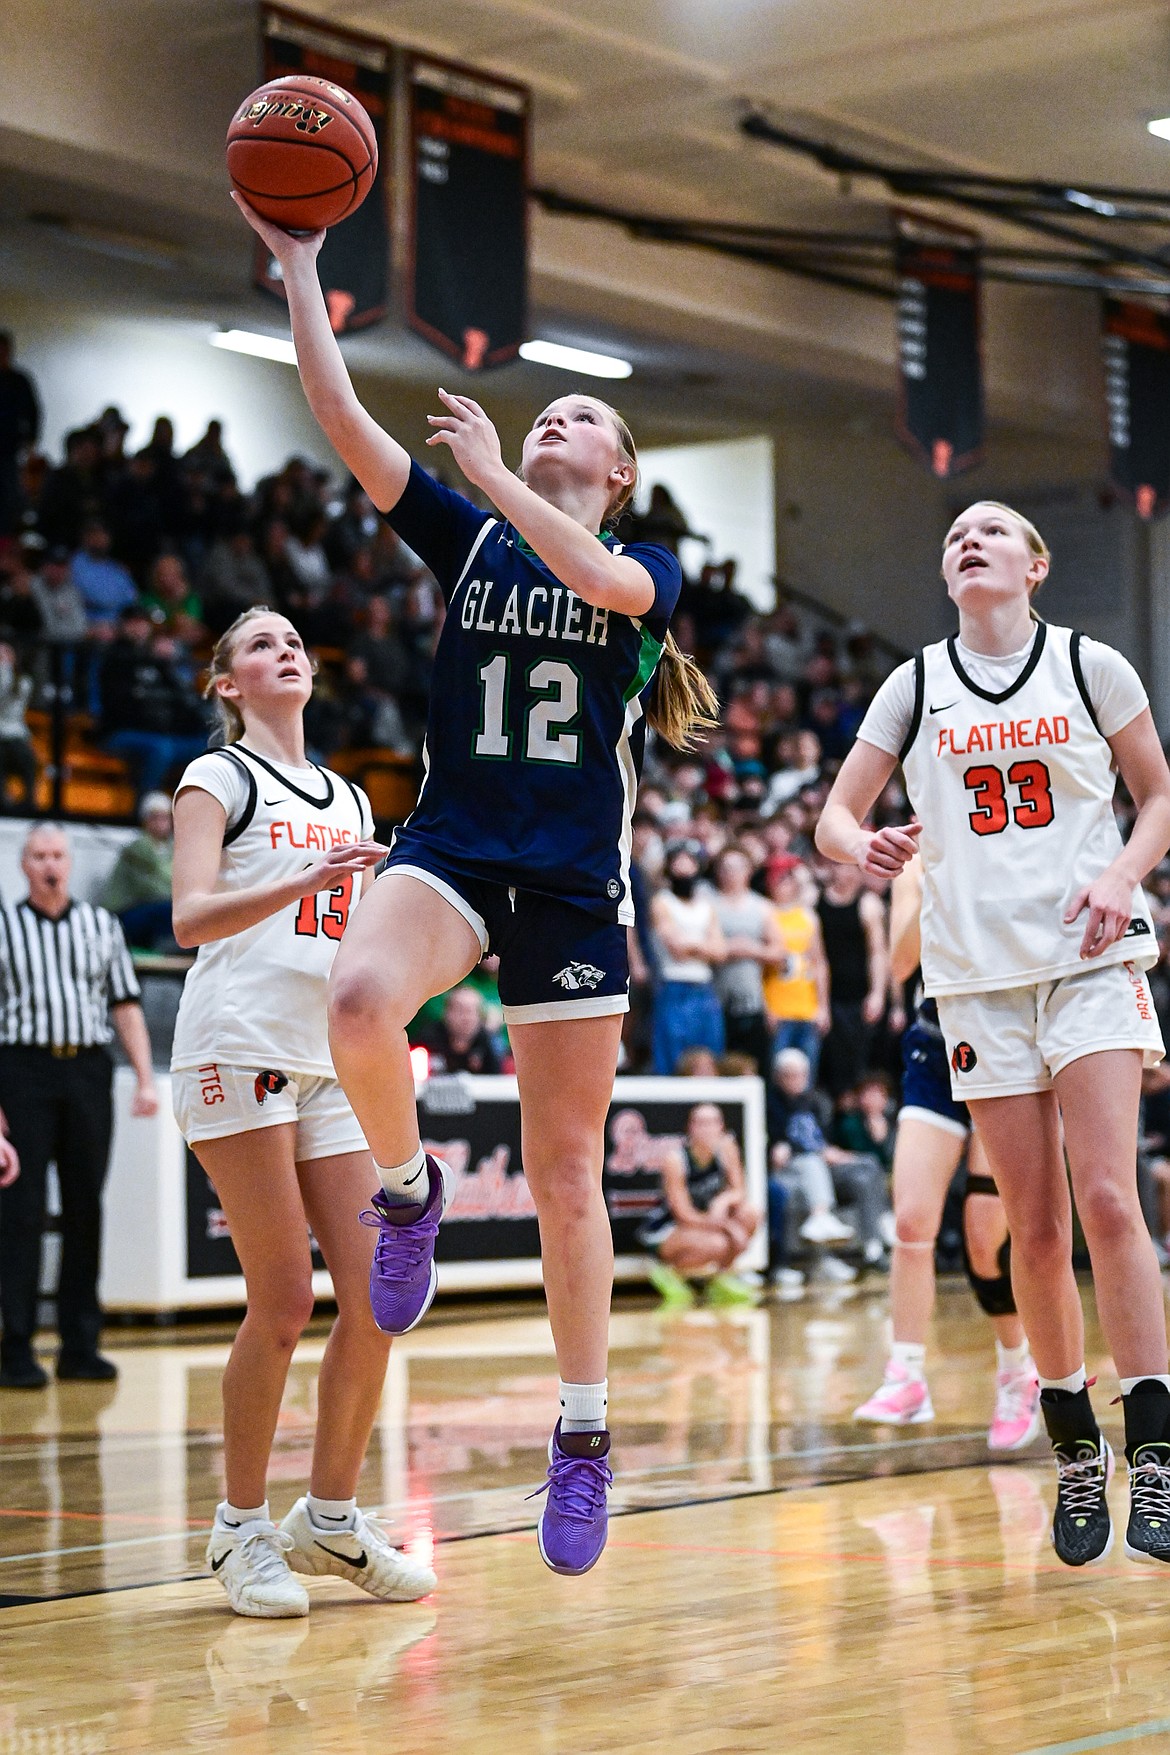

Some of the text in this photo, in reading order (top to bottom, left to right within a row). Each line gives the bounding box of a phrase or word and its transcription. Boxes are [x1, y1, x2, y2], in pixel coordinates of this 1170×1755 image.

[461, 579, 609, 646] GLACIER
[471, 651, 583, 768] 12
[937, 716, 1070, 757] FLATHEAD
[963, 759, 1055, 837] 33
[269, 821, 358, 852] FLATHE
[295, 862, 354, 942] 13
